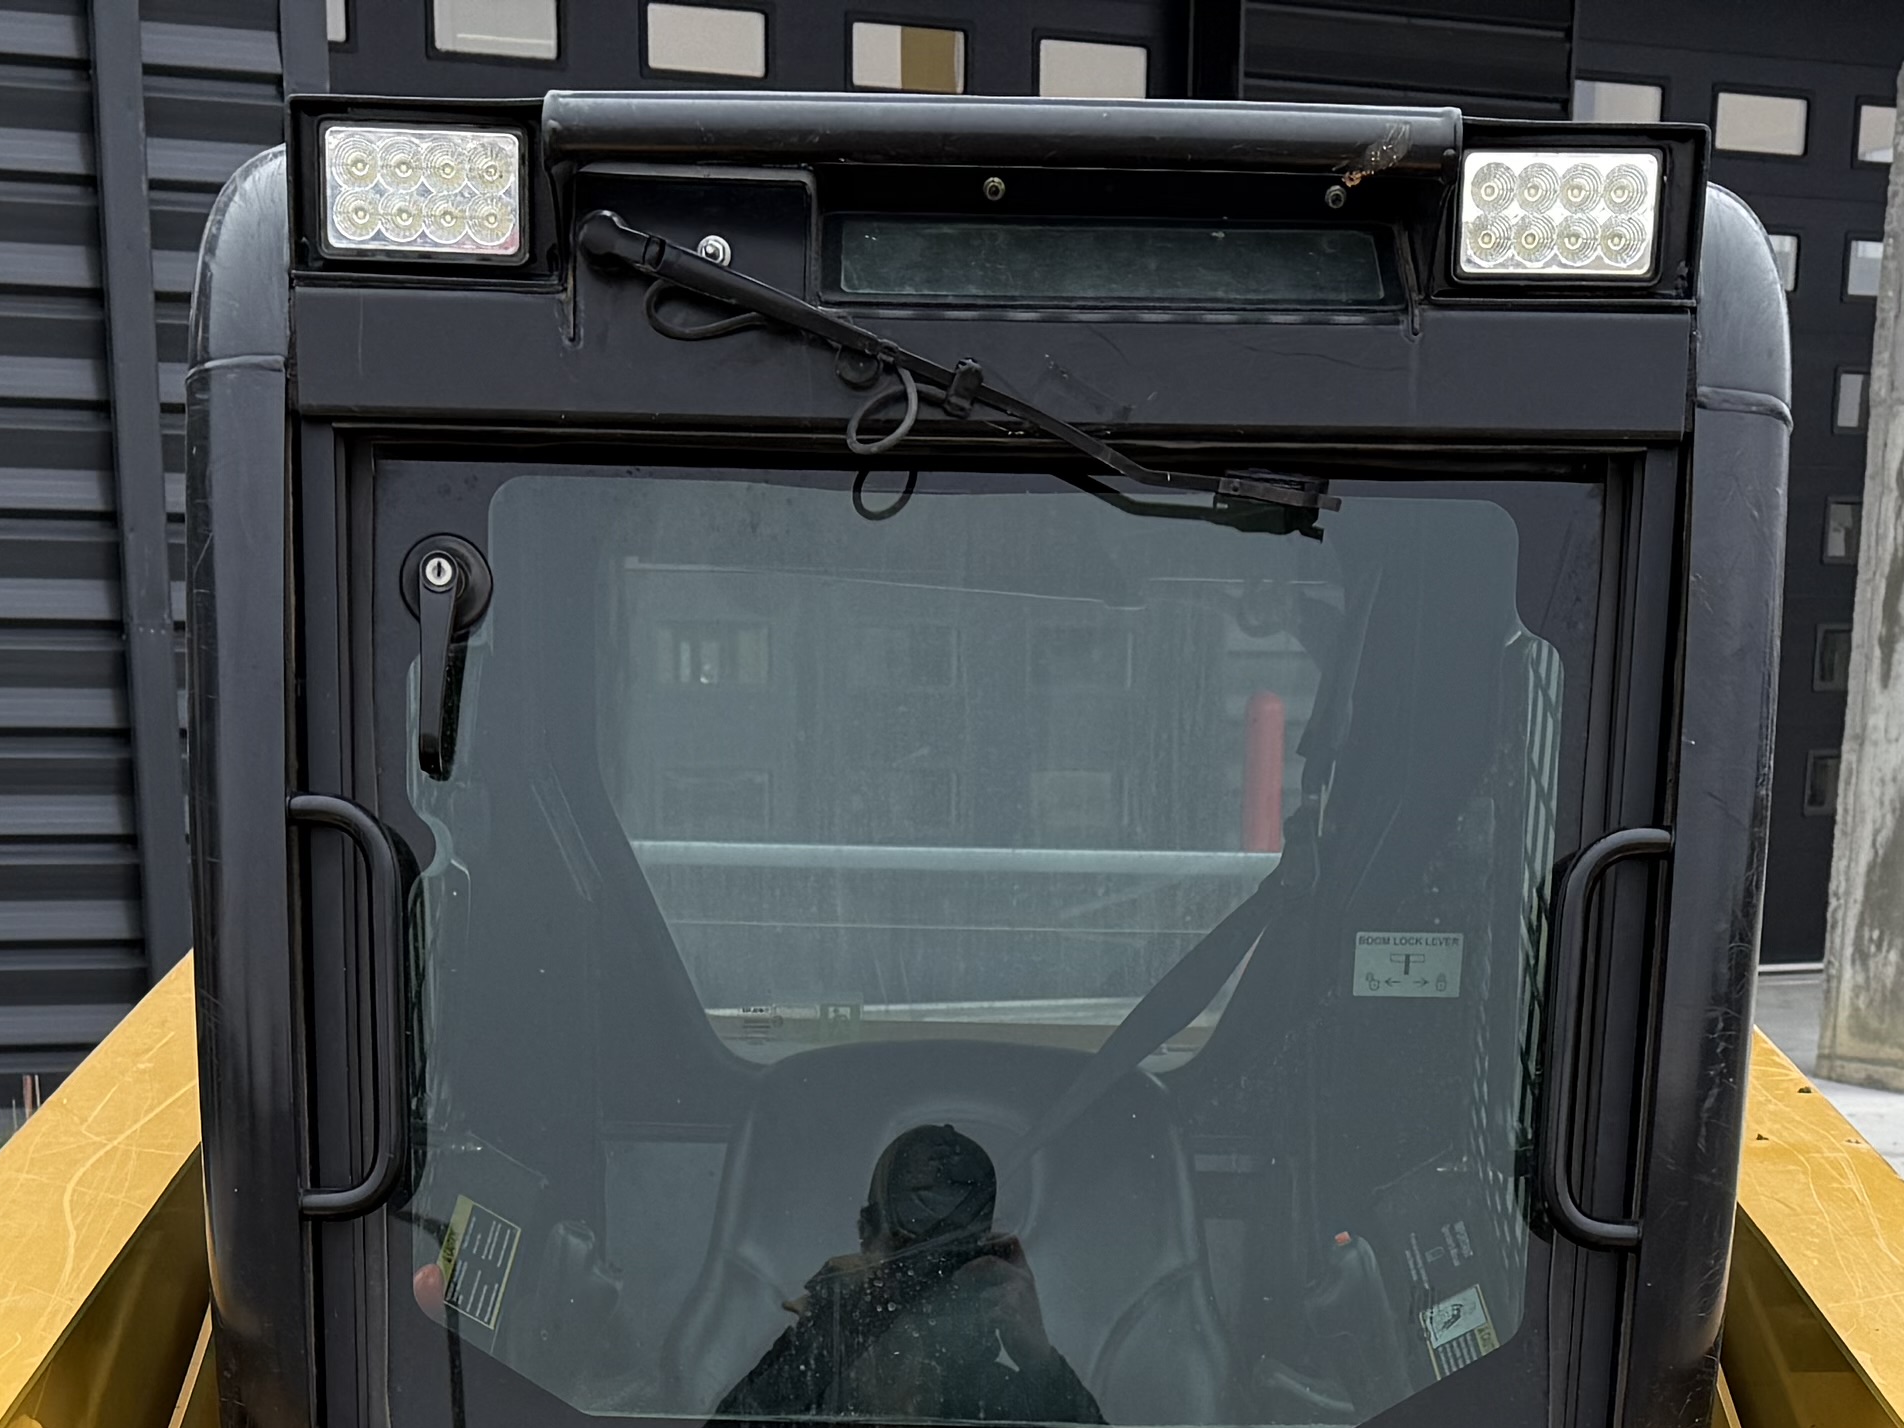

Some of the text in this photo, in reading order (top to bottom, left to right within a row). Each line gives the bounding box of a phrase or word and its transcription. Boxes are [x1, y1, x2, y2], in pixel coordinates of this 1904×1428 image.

[1358, 935, 1460, 947] BOOM LOCK LEVER
